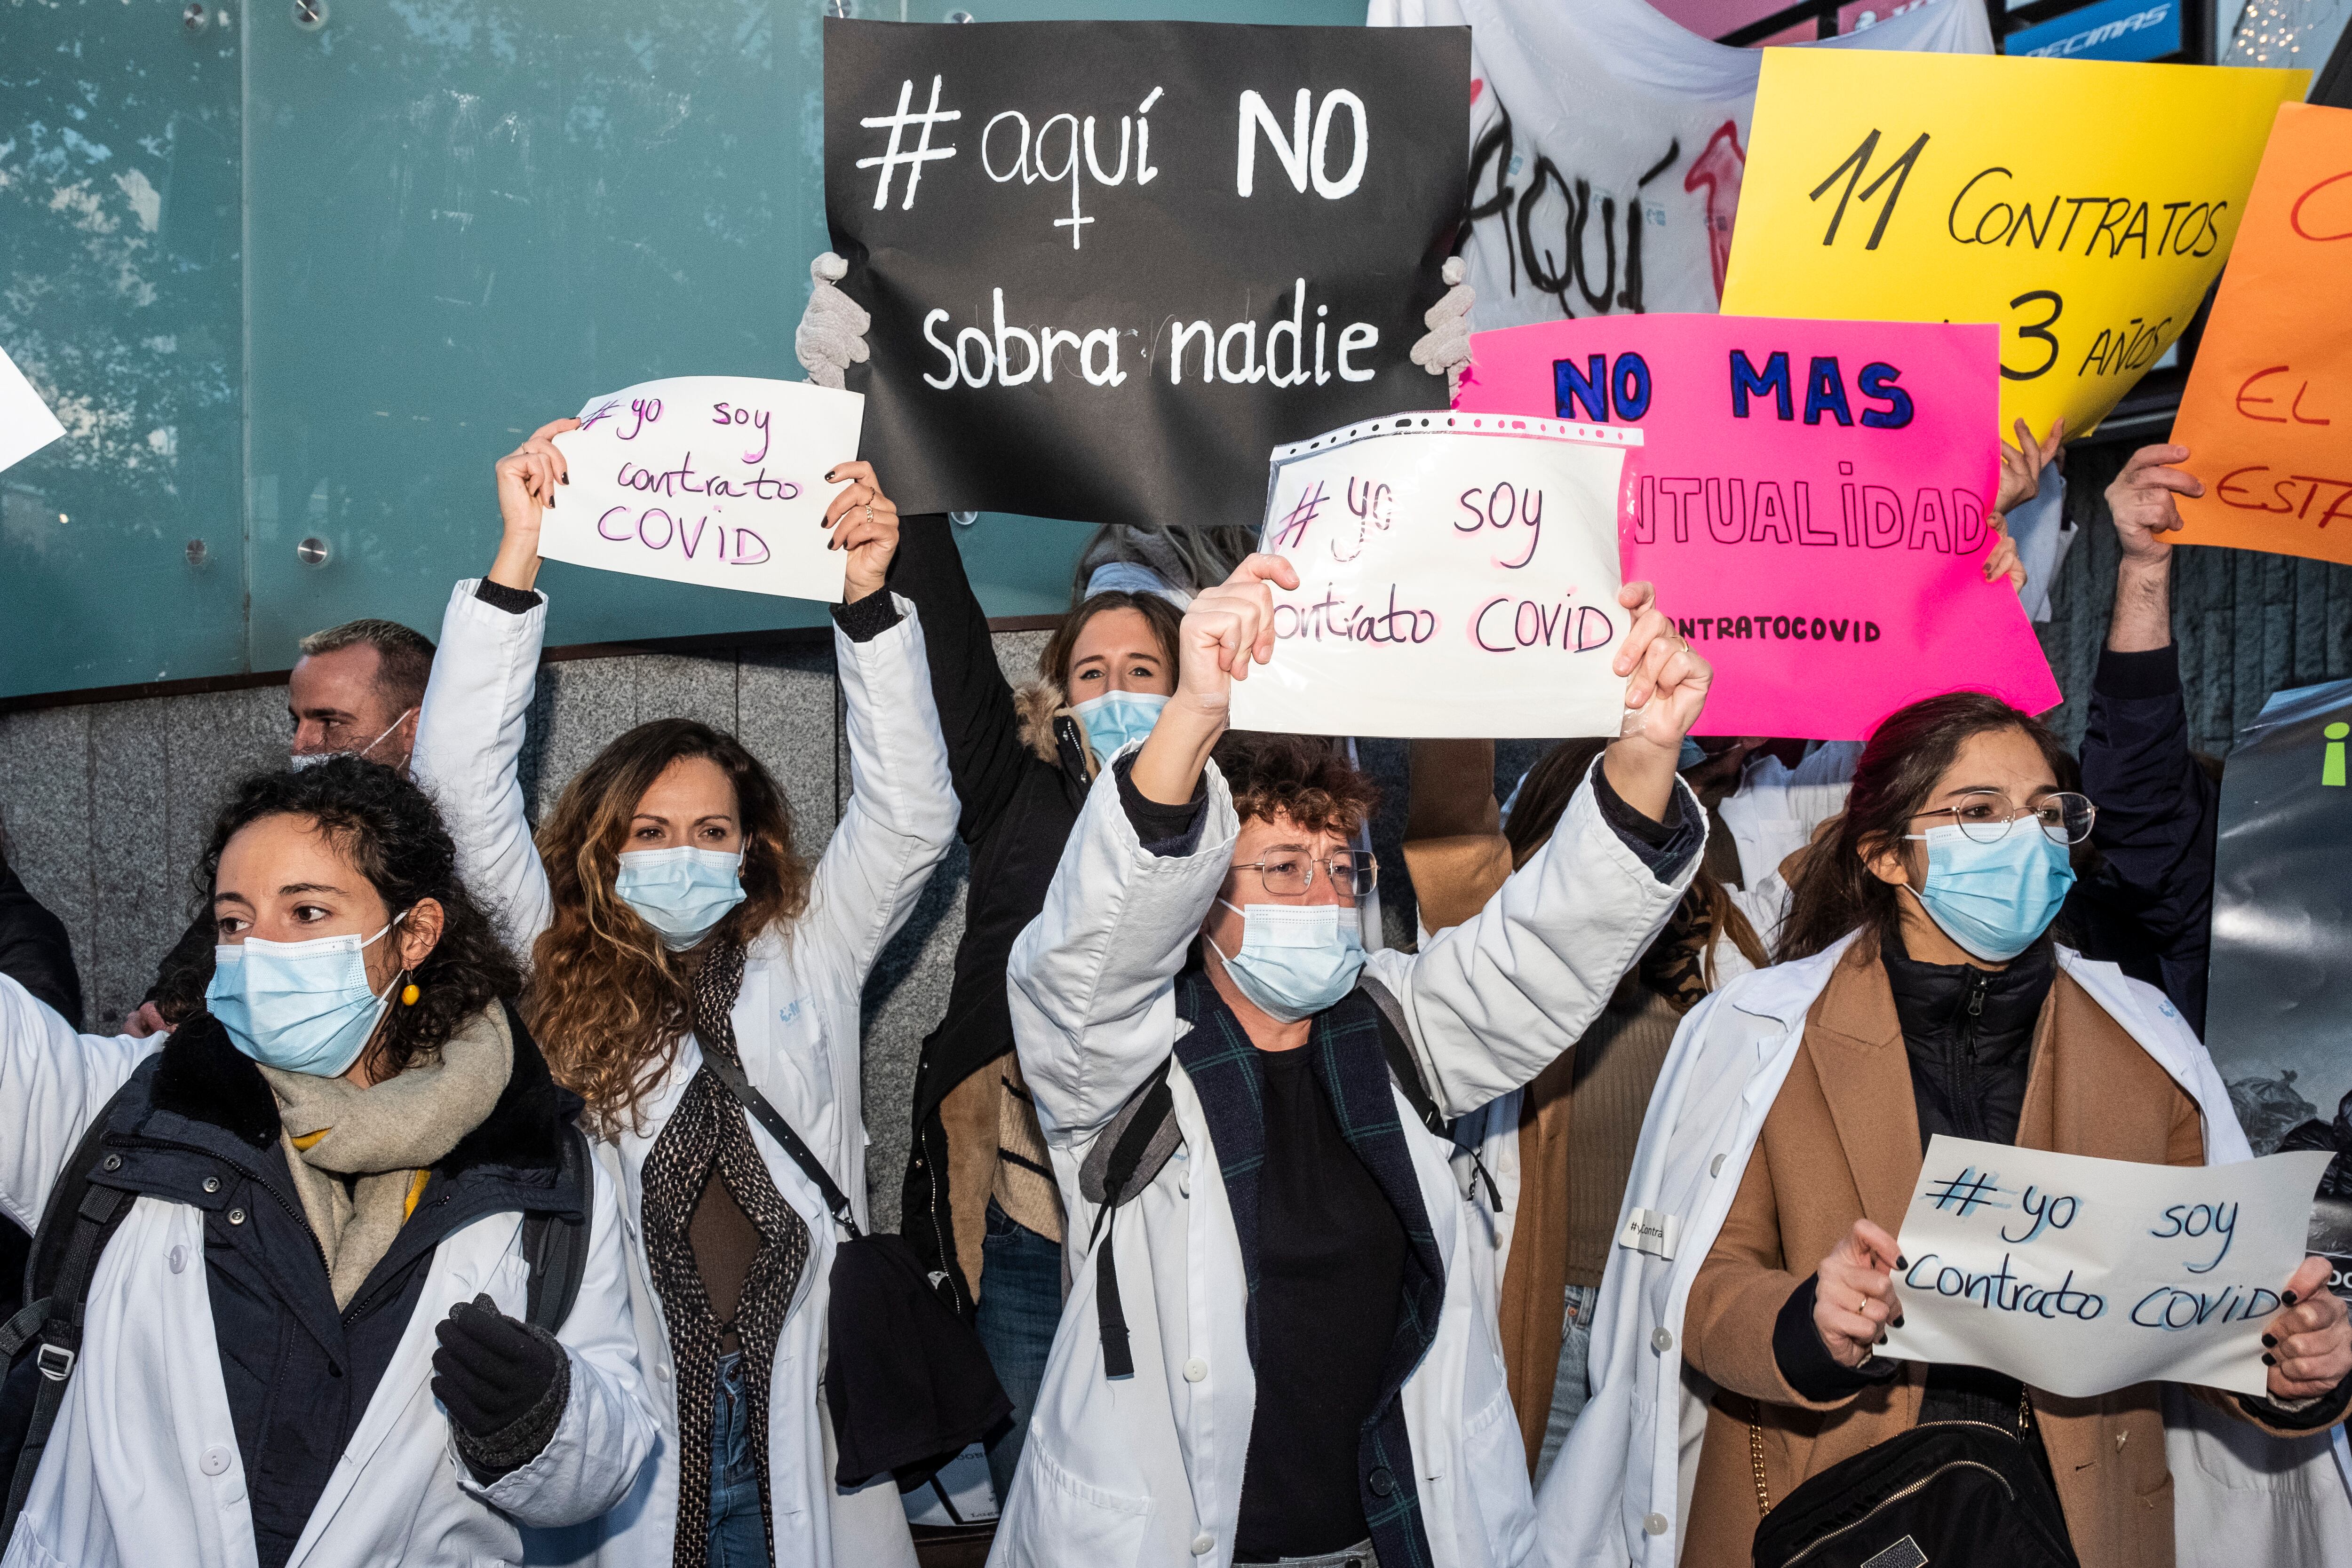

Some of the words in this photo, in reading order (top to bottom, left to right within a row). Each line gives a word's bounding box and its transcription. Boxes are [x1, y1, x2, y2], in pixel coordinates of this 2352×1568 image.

[1237, 88, 1368, 199] NO
[1809, 128, 1931, 250] 11
[1170, 277, 1378, 388] nadie
[2000, 290, 2063, 381] 3
[2078, 317, 2172, 376] AÑOS
[1552, 352, 1652, 422] NO
[1729, 349, 1914, 429] MAS
[2236, 365, 2330, 426] EL
[712, 402, 770, 464] soy
[1454, 481, 1542, 569] soy
[1274, 582, 1435, 643] ontrato
[1668, 616, 1881, 642] NTRATOCOVID
[2152, 1202, 2238, 1273] soy
